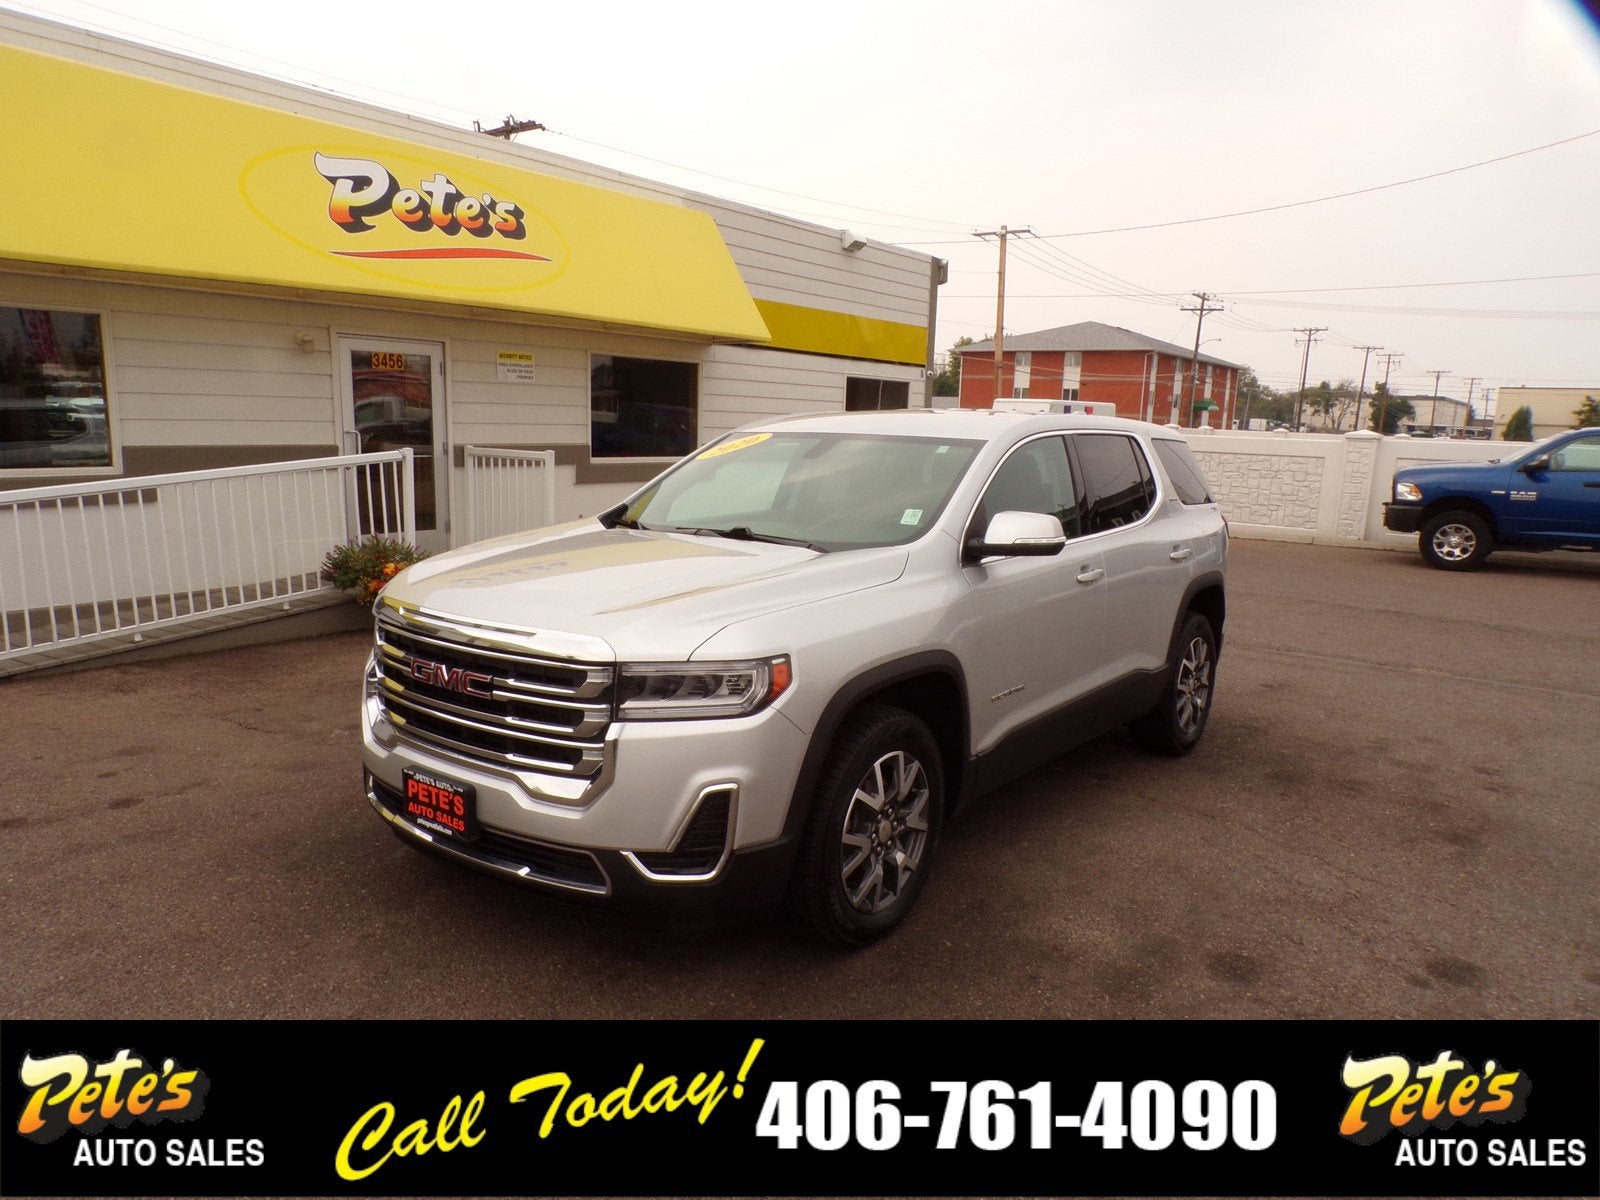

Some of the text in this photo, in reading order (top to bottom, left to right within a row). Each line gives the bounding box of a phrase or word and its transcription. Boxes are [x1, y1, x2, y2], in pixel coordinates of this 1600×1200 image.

[314, 151, 526, 240] Pete's
[373, 353, 403, 369] 3456
[411, 657, 493, 700] GMC
[408, 779, 464, 815] PETE'S
[408, 802, 434, 819] AUTO
[436, 811, 465, 831] SALES
